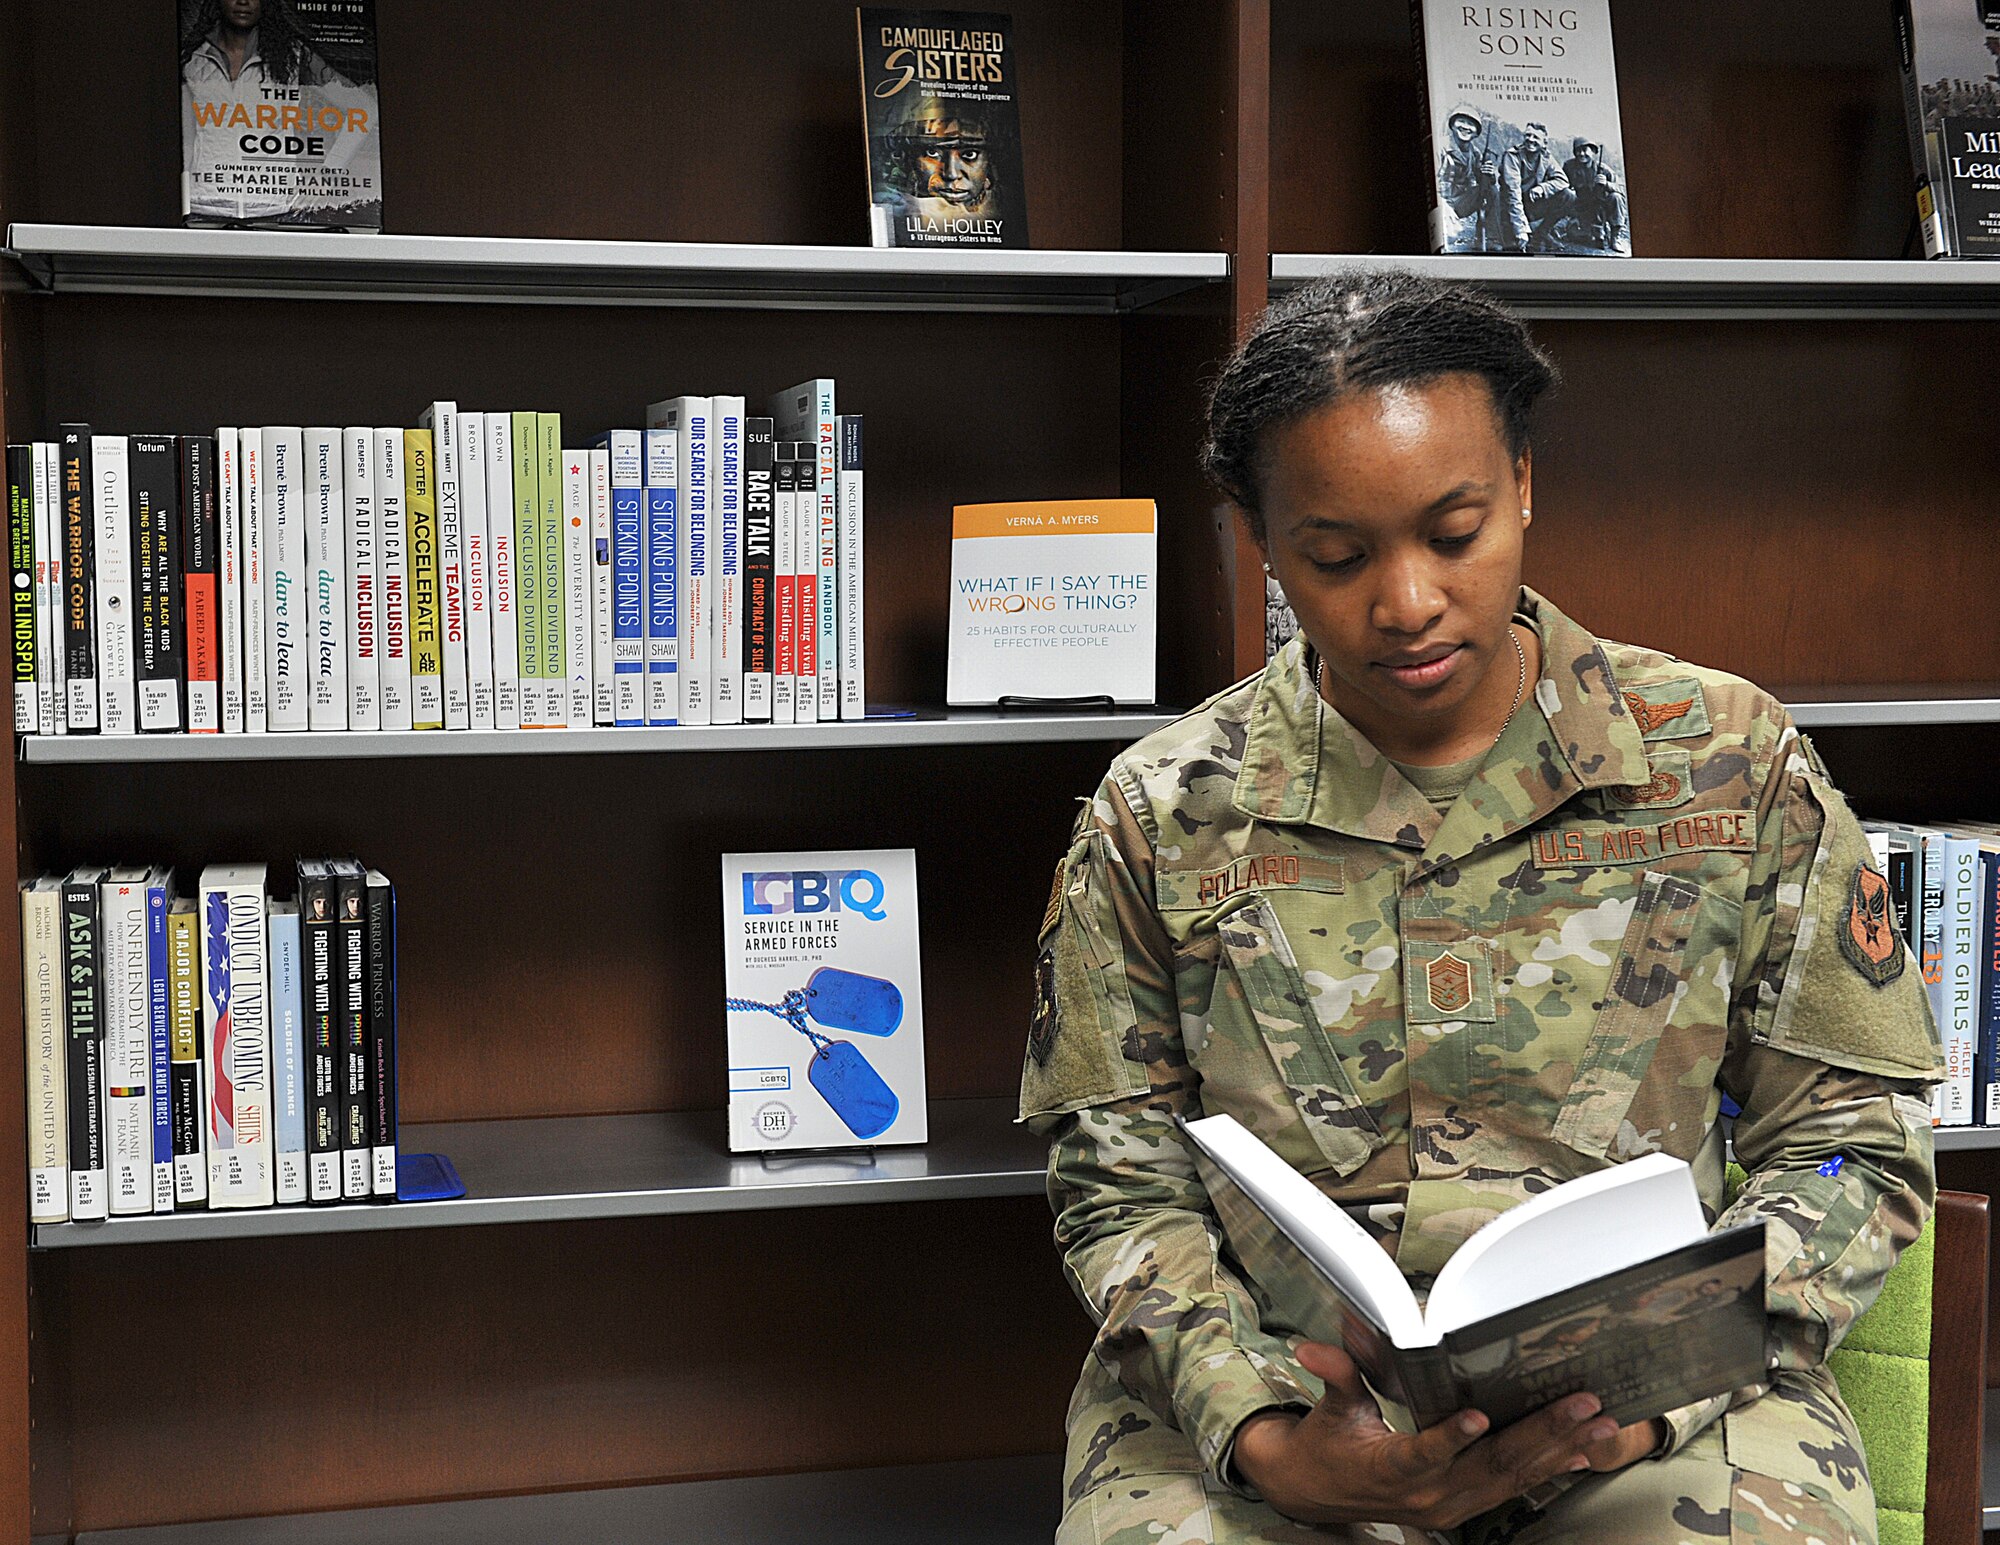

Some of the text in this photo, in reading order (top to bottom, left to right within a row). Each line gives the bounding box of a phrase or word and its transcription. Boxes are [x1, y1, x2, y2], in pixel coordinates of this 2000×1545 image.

[298, 3, 364, 13] INSIDE OF YOU
[1462, 6, 1578, 30] RISING
[881, 27, 1004, 52] CAMOUFLAGED
[1479, 34, 1566, 57] SONS
[260, 88, 300, 100] THE
[874, 48, 1002, 98] SISTERS
[920, 81, 946, 91] Revealing
[947, 82, 971, 92] Struggles
[972, 83, 978, 91] of
[1489, 75, 1524, 83] JAPANESE
[1527, 76, 1563, 84] AMERICAN
[192, 102, 369, 133] WARRIOR
[215, 164, 350, 176] GUNNERY SERGEANT (RET.)
[239, 135, 324, 156] CODE
[192, 172, 372, 188] TEE MARIE HANIBLE
[216, 186, 349, 197] WITH DENENE MILLNER
[907, 217, 1003, 235] LILA HOLLEY
[137, 443, 165, 452] Tatum
[191, 444, 199, 461] THE
[468, 425, 476, 461] BROWN
[749, 434, 770, 443] SUE
[192, 463, 200, 533] POST-AMERICAN
[276, 444, 287, 525] Brené Brown
[415, 450, 425, 496] KOTTER
[690, 417, 705, 576] OUR SEARCH FOR BELONGING
[103, 471, 119, 540] Outliers
[443, 482, 458, 560] EXTREME
[748, 470, 770, 556] RACE TALK
[820, 393, 833, 637] THE RACIAL HEALING HANDBOOK
[1006, 515, 1099, 526] VERNÁ A. MYERS
[67, 458, 84, 630] THE WARRIOR CODE
[522, 520, 534, 599] INCLUSION
[617, 500, 639, 626] STICKING POINTS
[850, 540, 856, 551] IN
[140, 491, 154, 670] SITTING TOGETHER IN THE CAFETERIA?
[157, 510, 170, 651] WHY ARE ALL THE BLACK KIDS
[356, 497, 373, 658] RADICAL INCLUSION
[414, 512, 433, 642] ACCELERATE
[471, 536, 482, 612] INCLUSION
[958, 574, 1148, 594] WHAT IF I SAY THE
[275, 570, 292, 638] dare to
[446, 564, 462, 642] TEAMING
[752, 578, 764, 648] CONSPIRACY OF
[777, 586, 793, 642] whistling
[968, 594, 1137, 614] WRONG THING?
[15, 592, 33, 682] BLINDSPOT
[524, 605, 535, 674] DIVIDEND
[617, 645, 641, 656] SHAW
[967, 624, 1137, 636] 25 HABITS FOR CULTURALLY
[994, 637, 1108, 648] EFFECTIVE PEOPLE
[1539, 813, 1748, 864] U.S. AIR FORCE
[68, 894, 90, 902] ESTES
[742, 869, 887, 922] LGBTQ
[1200, 854, 1298, 906] POLLARD
[744, 919, 840, 934] SERVICE IN THE
[745, 936, 837, 951] ARMED FORCES
[1923, 878, 1942, 985] MERCURY 13
[1954, 854, 1972, 1031] SOLDIER GIRLS
[68, 912, 94, 1038] ASK & TELL
[314, 930, 329, 1012] FIGHTING WITH
[371, 902, 384, 1018] WARRIOR PRINCESS
[127, 909, 145, 1078] UNFRIENDLY FIRE
[176, 929, 192, 1044] MAJOR CONFLICT
[230, 894, 264, 1093] CONDUCT UNBECOMING
[153, 979, 168, 1126] LGBTQ SERVICE IN THE ARMED FORCES
[285, 1010, 295, 1116] SOLDIER OF CHANGE
[237, 1105, 261, 1144] SHILTS
